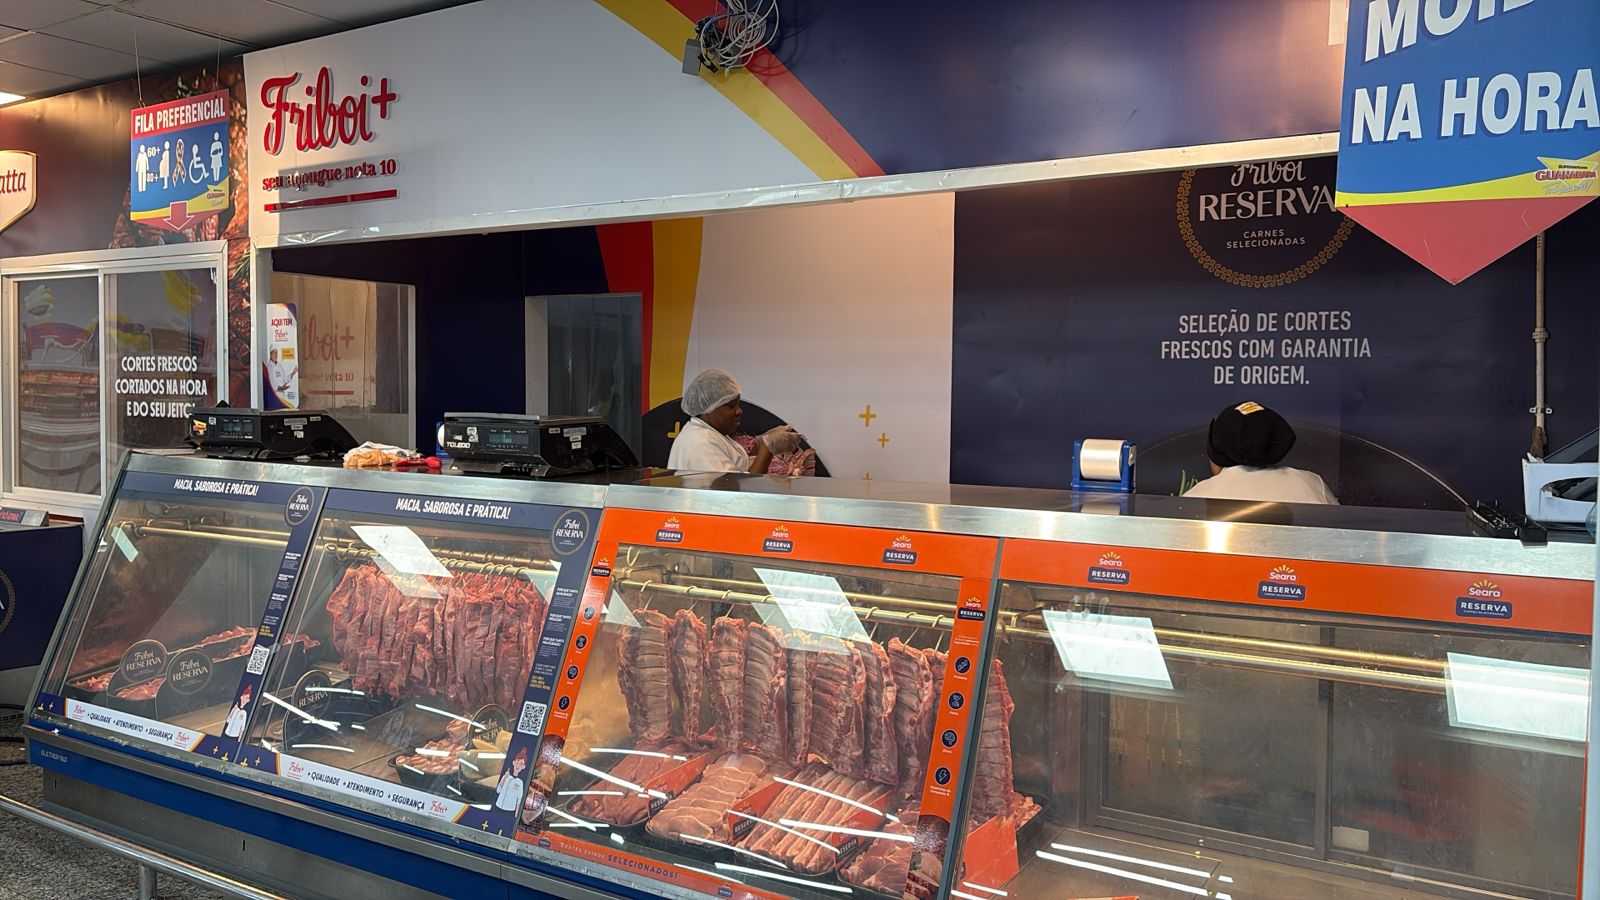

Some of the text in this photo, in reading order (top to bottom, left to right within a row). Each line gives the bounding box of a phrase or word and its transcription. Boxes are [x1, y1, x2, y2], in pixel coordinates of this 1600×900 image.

[1351, 68, 1600, 144] NA HORA
[135, 97, 225, 134] FILA PREFERENCIAL
[147, 146, 160, 157] 60+
[262, 175, 283, 191] seu
[345, 161, 376, 178] nota
[380, 158, 397, 176] 10
[1199, 185, 1337, 222] RESERVA
[1243, 229, 1285, 239] CARNES
[1226, 237, 1306, 249] SELECIONADAS
[1178, 309, 1352, 336] SELEÇÃO DE CORTES
[1161, 338, 1372, 359] FRESCOS COM GARANTIA
[122, 356, 198, 372] CORTES FRESCOS
[1213, 365, 1310, 385] DE ORIGEM.
[114, 378, 208, 396] CORTADOS NA HORA
[126, 401, 132, 416] E
[133, 401, 148, 417] DO
[150, 401, 166, 418] SEU
[446, 441, 470, 449] TOLEDO
[174, 478, 260, 496] MACIA, SABOROSA E PRÁTICA!
[396, 498, 512, 520] MACIA, SABOROSA E PRÁTICA!
[556, 528, 584, 539] RESERVA
[886, 552, 914, 560] RESERVA
[1098, 558, 1123, 567] Seara
[1091, 570, 1127, 579] RESERVA
[1269, 571, 1296, 581] Seara
[1262, 586, 1302, 595] RESERVA
[1468, 587, 1501, 598] Seara
[1460, 601, 1508, 612] RESERVA
[126, 656, 162, 672] RESERVA
[172, 666, 208, 682] RESERVA
[607, 854, 678, 880] SELECIONADOS!
